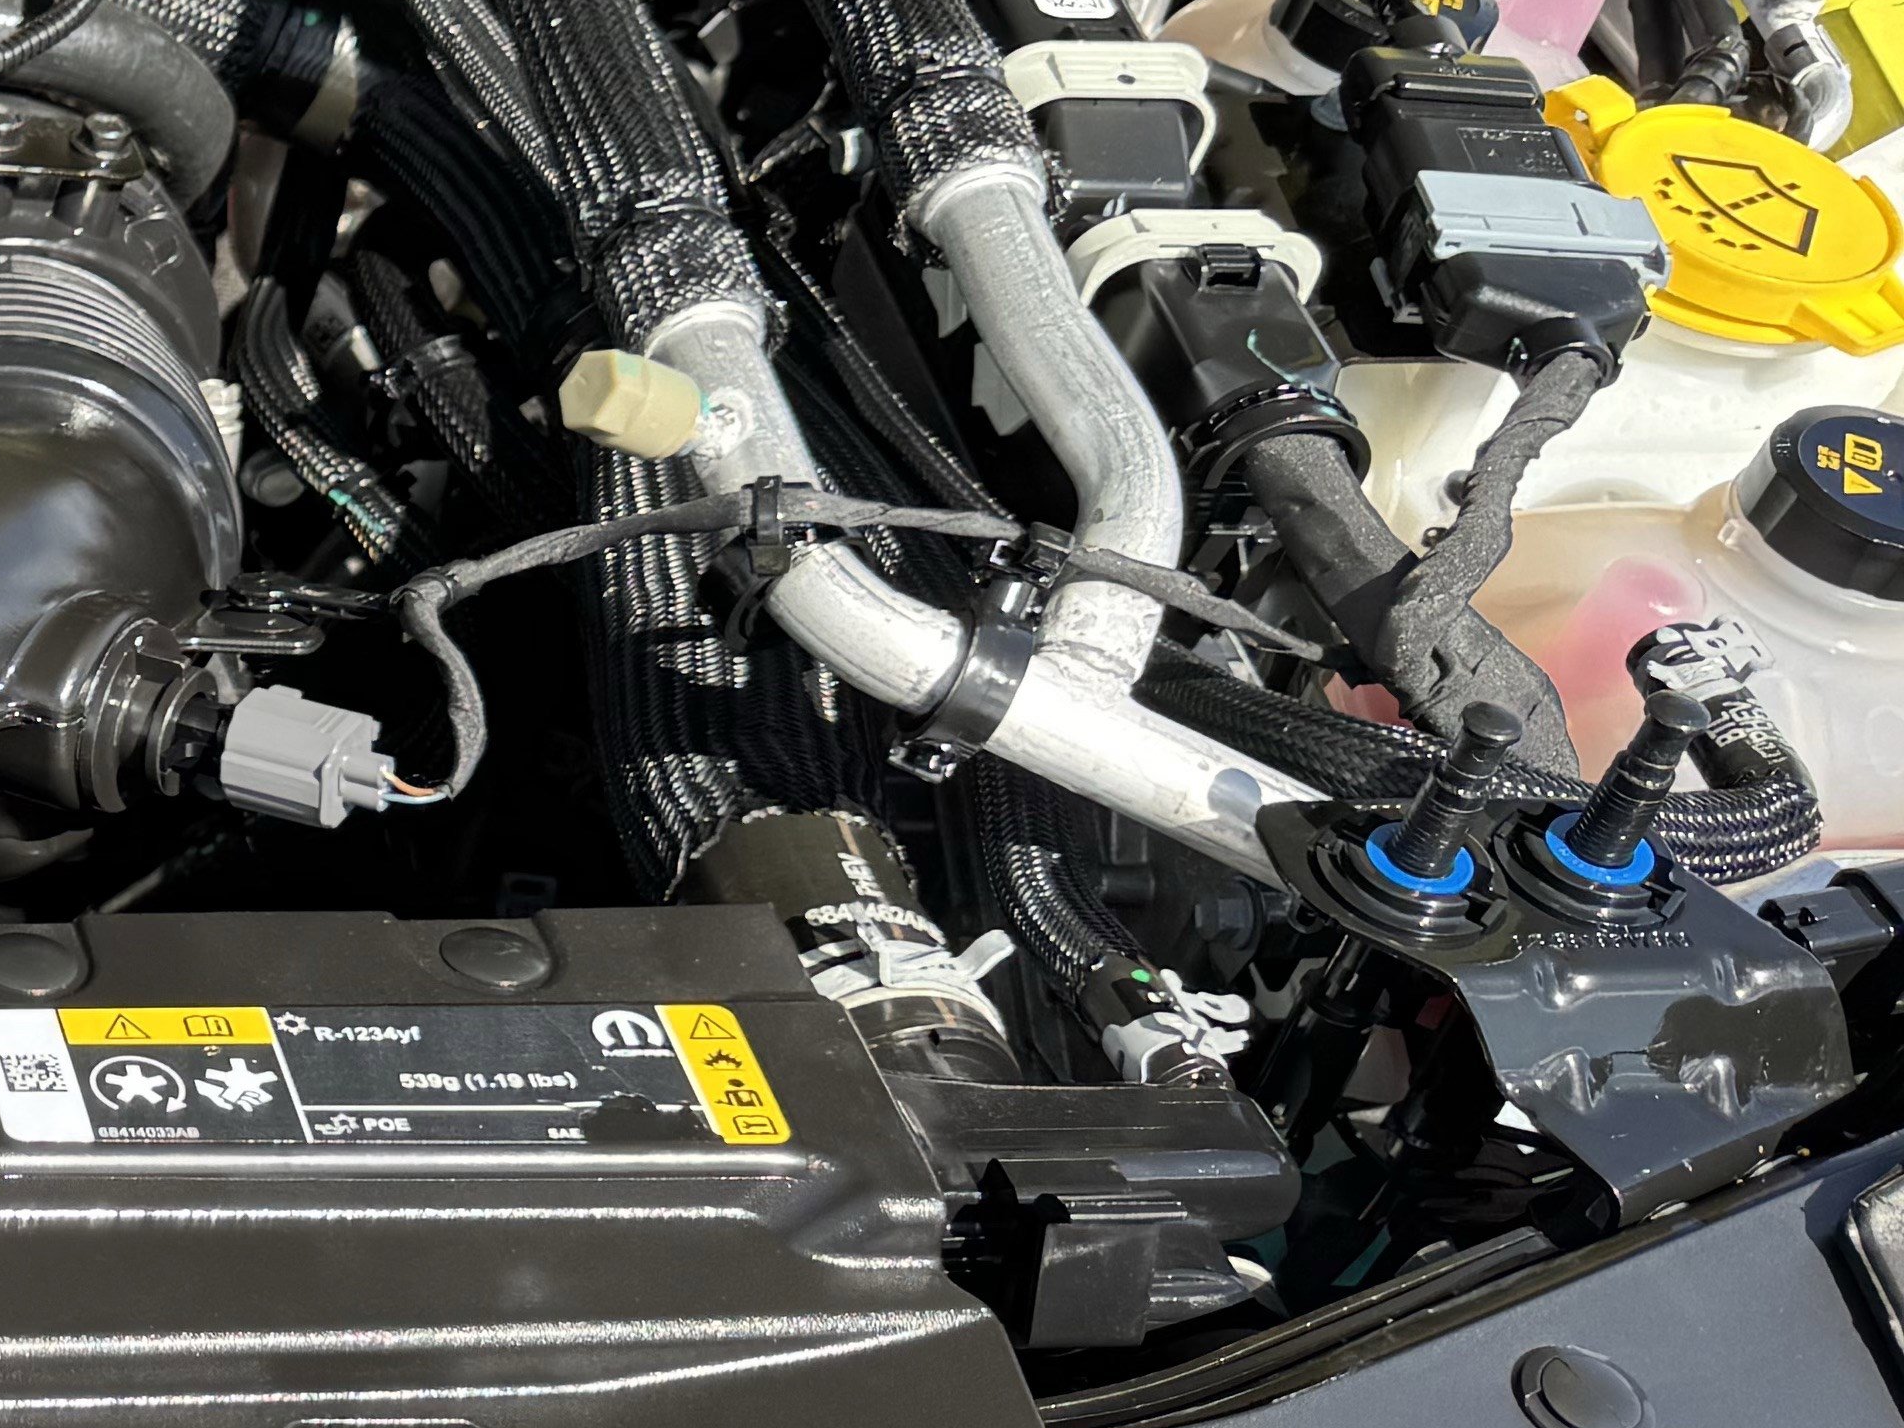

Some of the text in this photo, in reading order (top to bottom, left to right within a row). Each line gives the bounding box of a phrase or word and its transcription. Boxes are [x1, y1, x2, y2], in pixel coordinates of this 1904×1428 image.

[314, 1026, 421, 1045] R-1234yf
[399, 1071, 578, 1092] 539g (1.19 lbs)
[363, 1117, 411, 1132] POE
